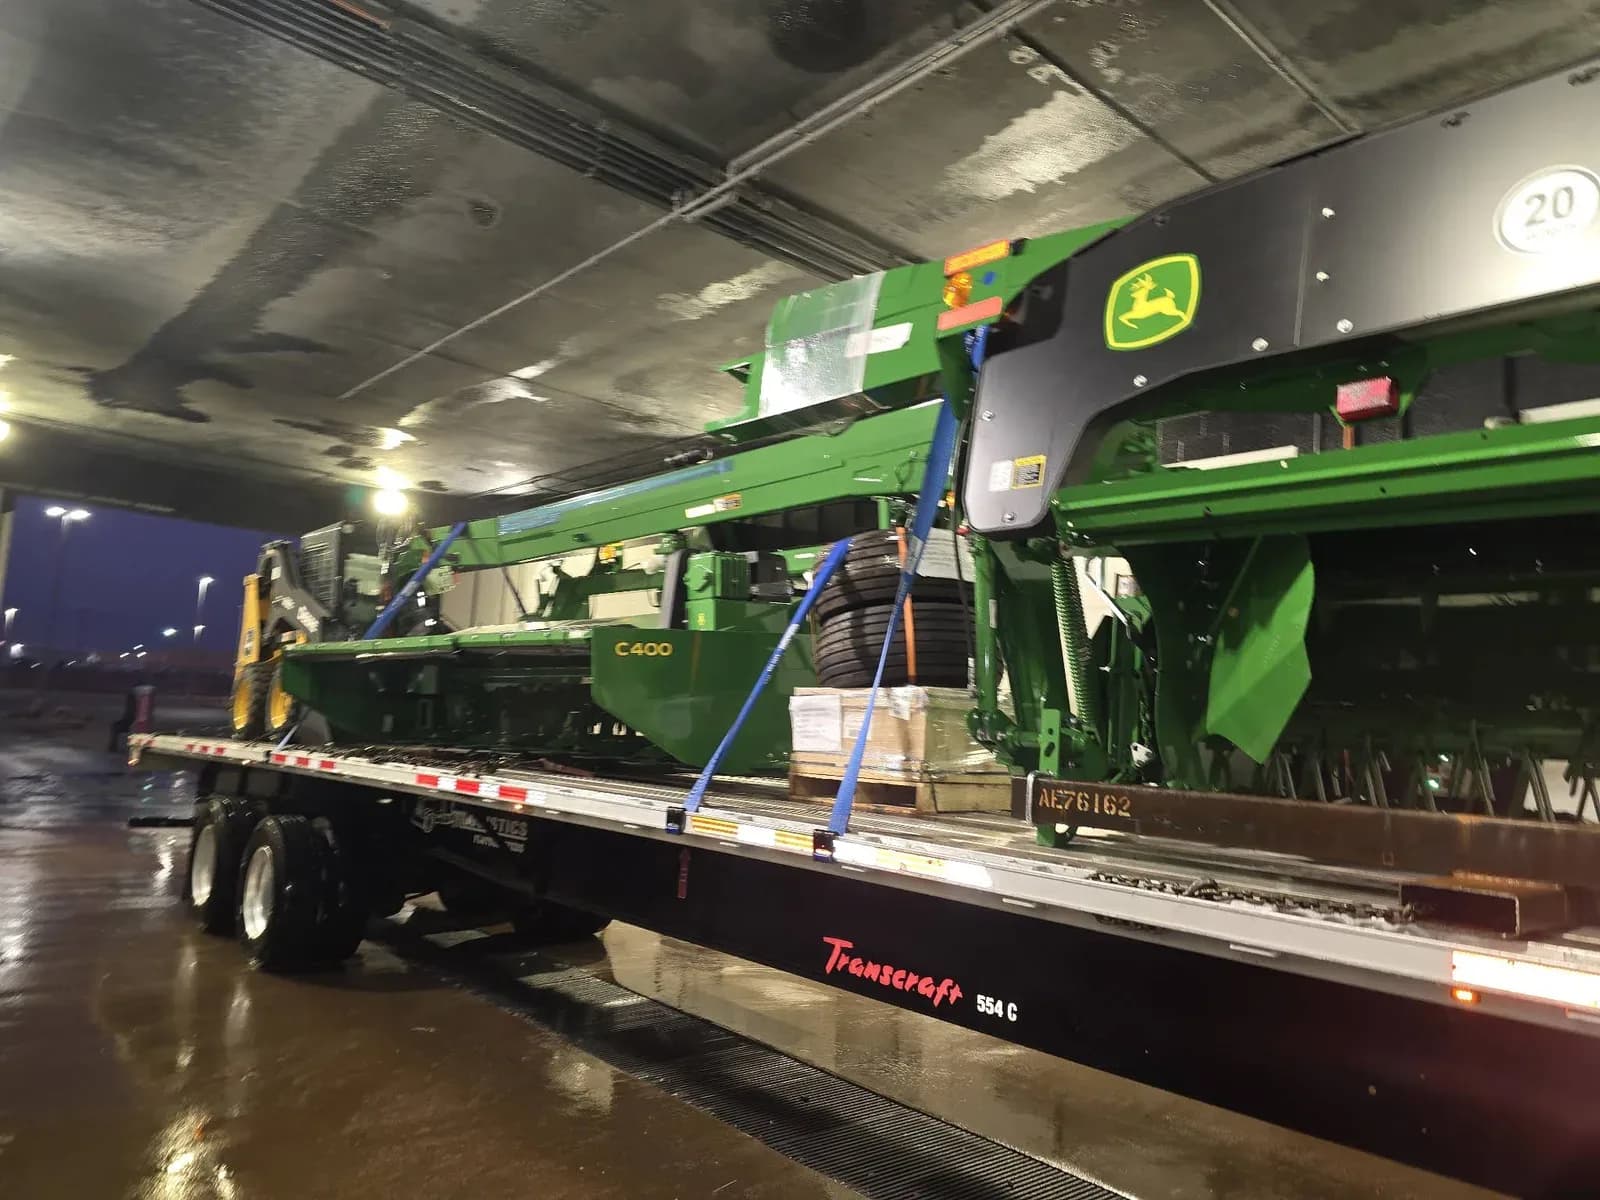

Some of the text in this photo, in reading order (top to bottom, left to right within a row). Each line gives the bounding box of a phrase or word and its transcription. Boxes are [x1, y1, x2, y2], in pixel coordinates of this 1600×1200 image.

[1524, 185, 1575, 227] 20
[614, 641, 673, 656] C400
[1038, 787, 1132, 818] AE76162
[822, 936, 1018, 1022] Transcraft 554 C
